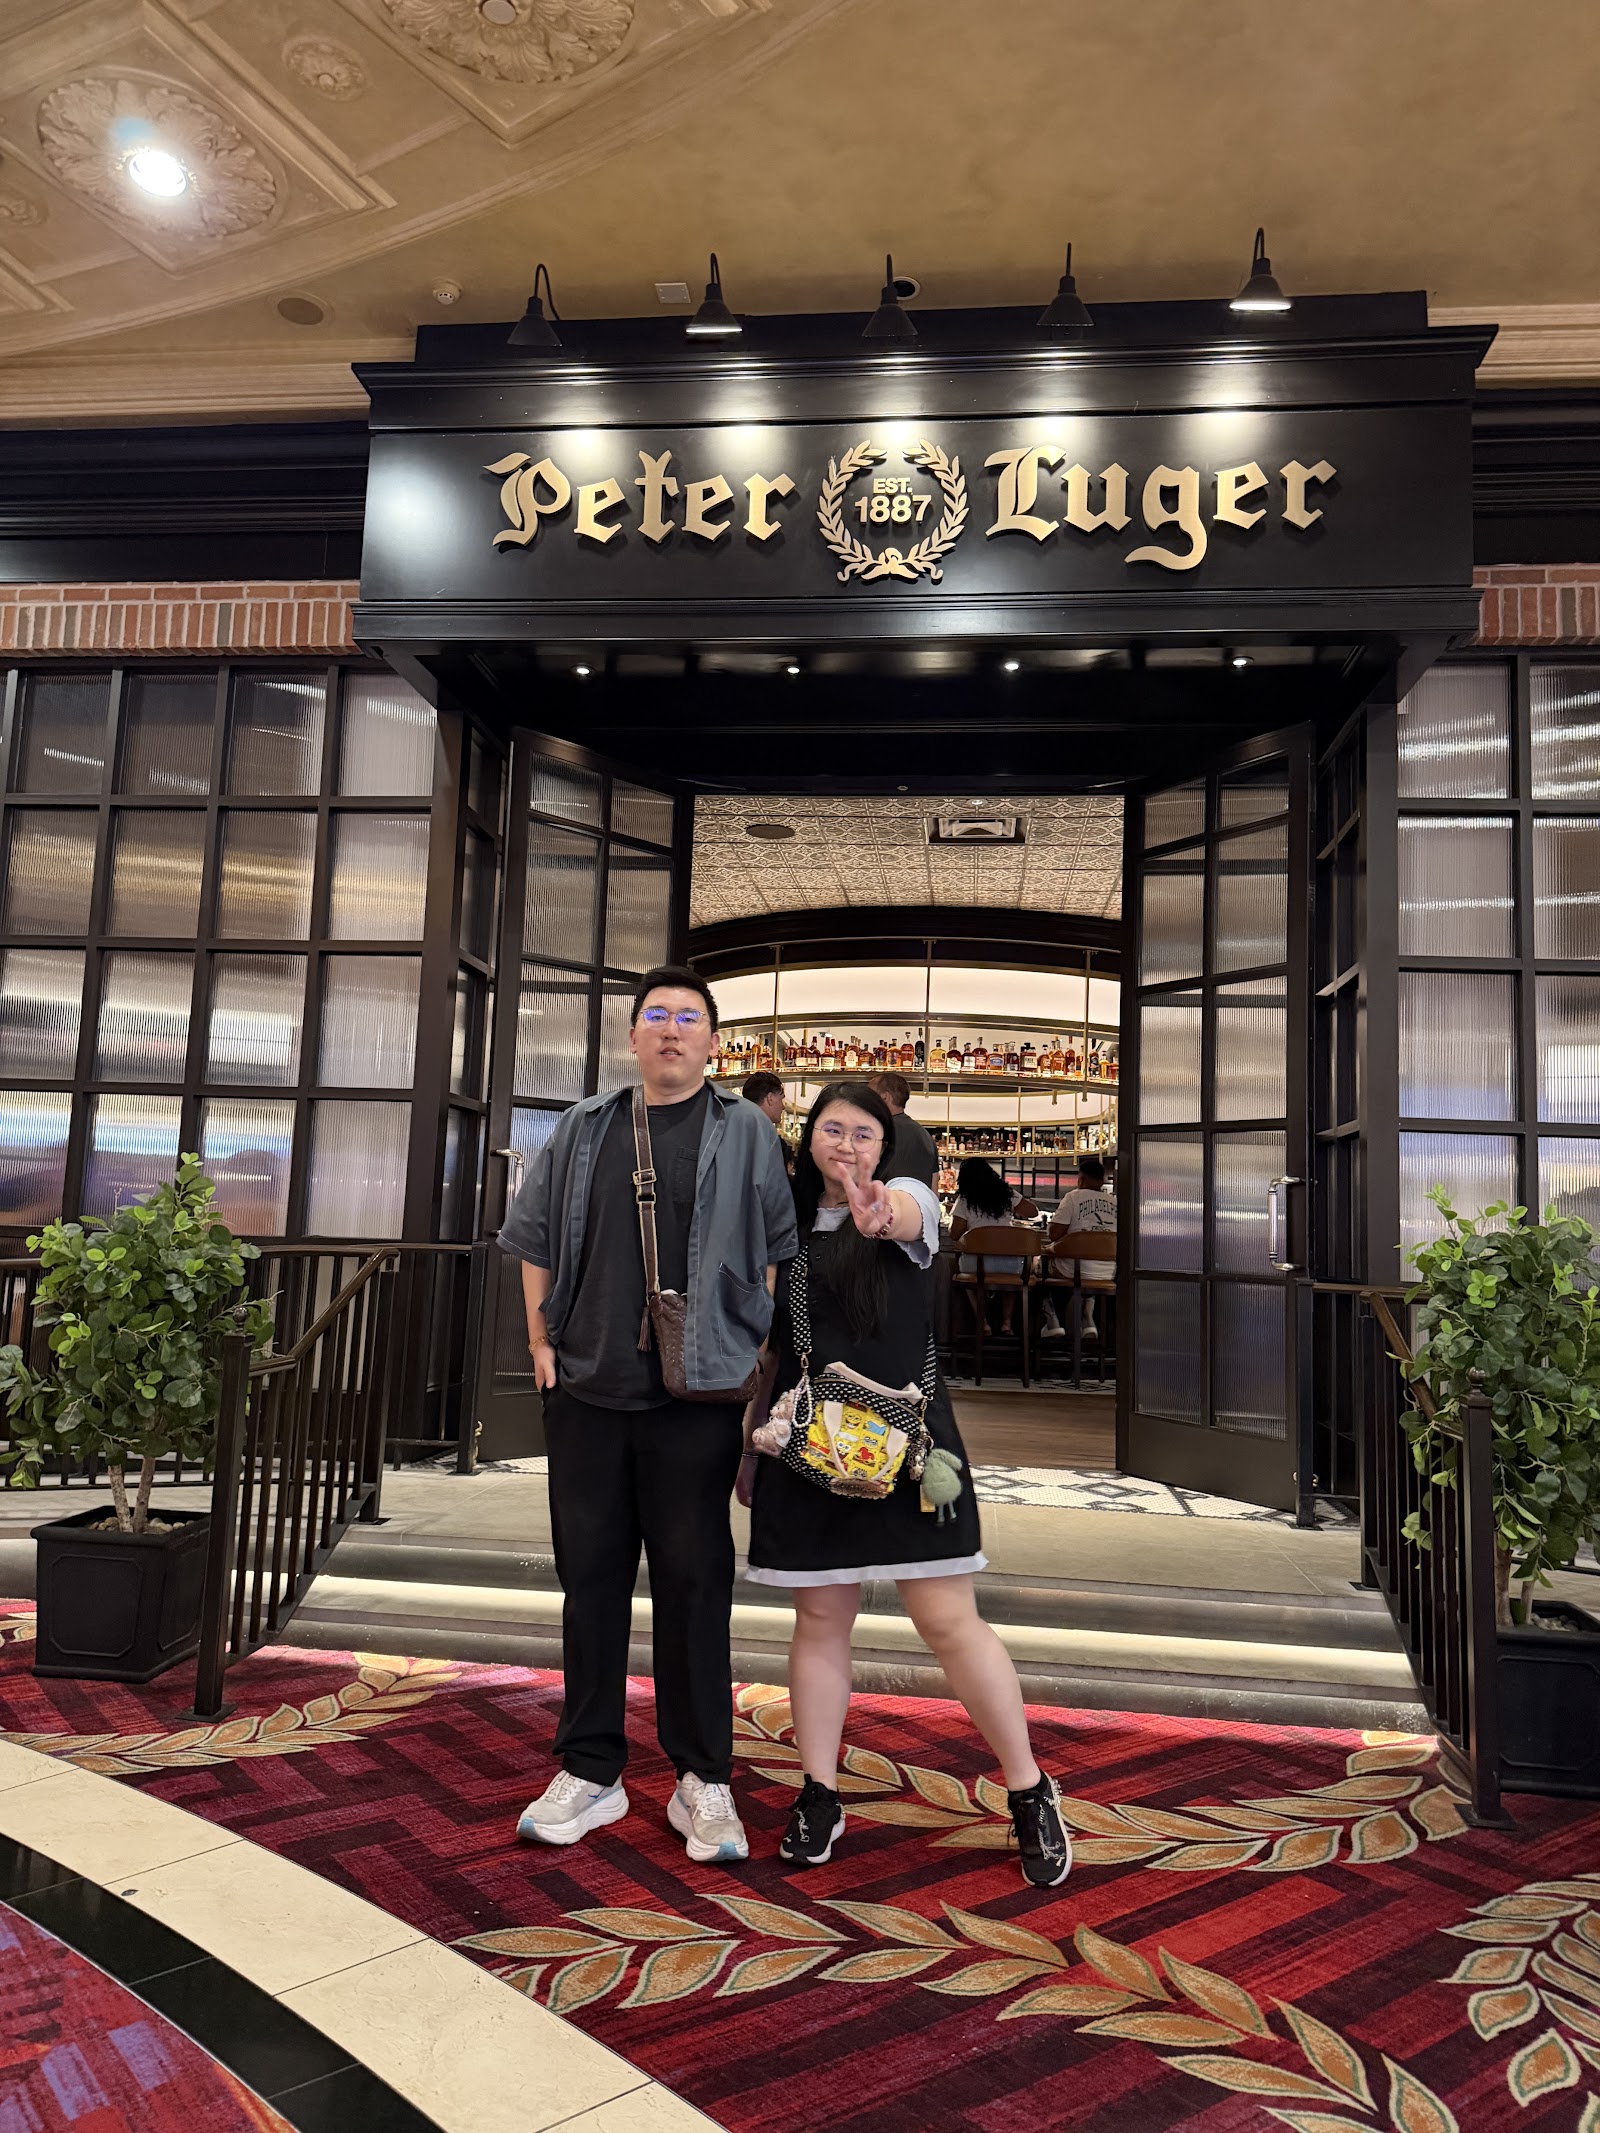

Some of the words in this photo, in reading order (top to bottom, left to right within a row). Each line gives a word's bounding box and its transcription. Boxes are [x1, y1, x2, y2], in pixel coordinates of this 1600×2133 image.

[873, 477, 913, 494] EST.
[482, 449, 796, 546] Peter
[984, 445, 1337, 570] Luger
[854, 495, 932, 523] 1887
